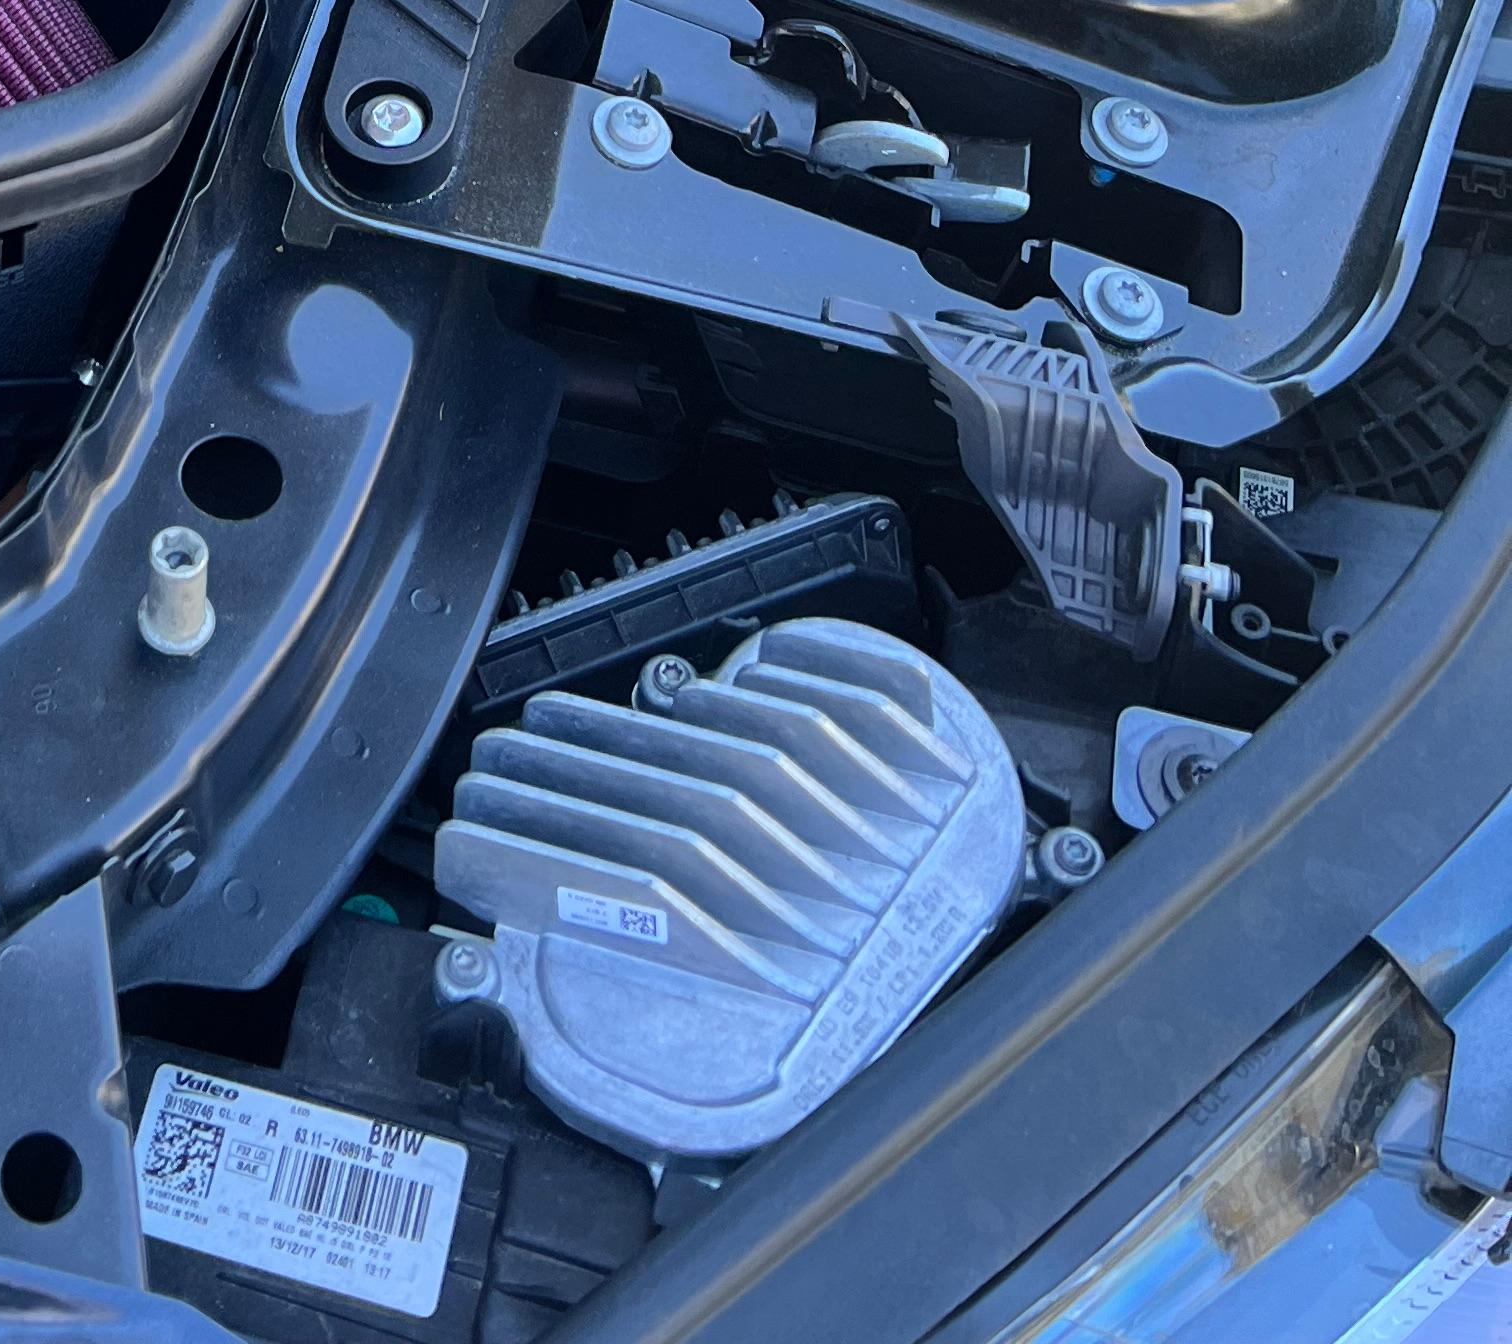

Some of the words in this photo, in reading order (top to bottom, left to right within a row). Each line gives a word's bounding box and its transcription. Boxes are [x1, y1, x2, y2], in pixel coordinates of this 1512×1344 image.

[175, 1071, 240, 1101] Valeo
[369, 1120, 426, 1156] BMW
[238, 1113, 252, 1126] 02
[265, 1120, 279, 1138] R
[235, 1161, 259, 1175] SAE
[145, 1200, 171, 1216] MADE
[172, 1206, 183, 1218] IN
[271, 1236, 317, 1259] 13/12/17
